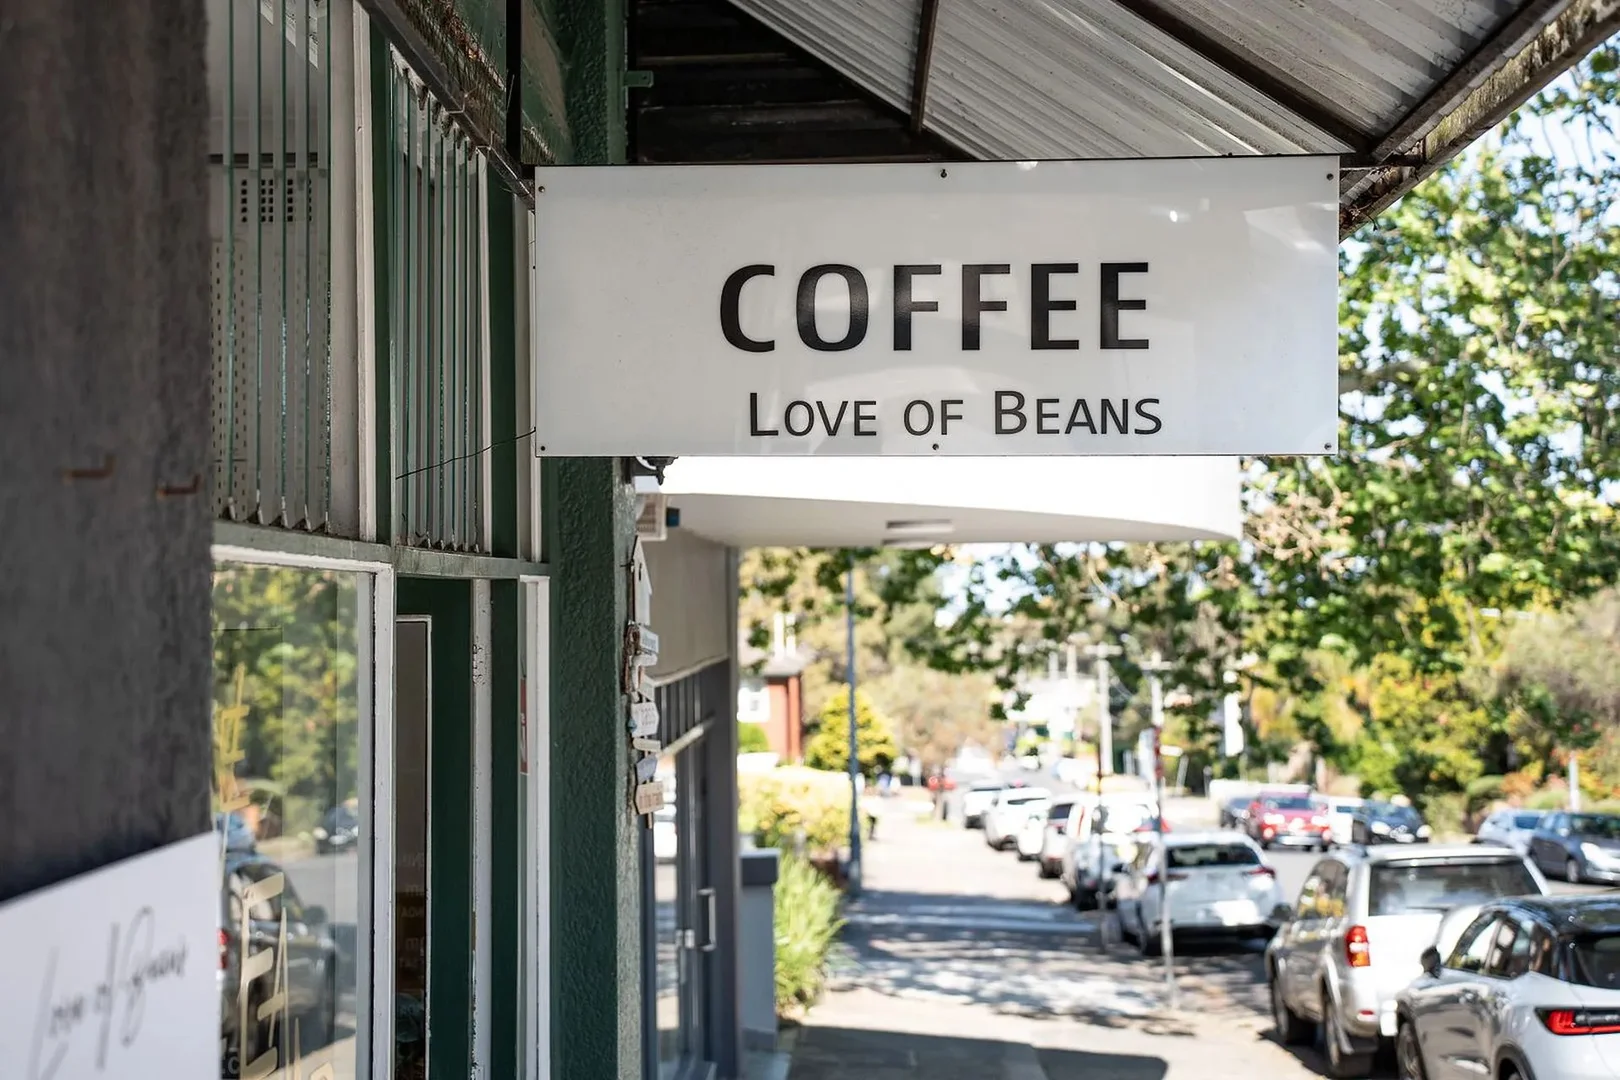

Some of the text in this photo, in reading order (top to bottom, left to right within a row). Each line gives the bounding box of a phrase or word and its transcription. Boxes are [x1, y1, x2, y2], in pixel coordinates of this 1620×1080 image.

[719, 262, 1150, 353] COFFEE
[749, 390, 1162, 437] LOVE OF BEANS
